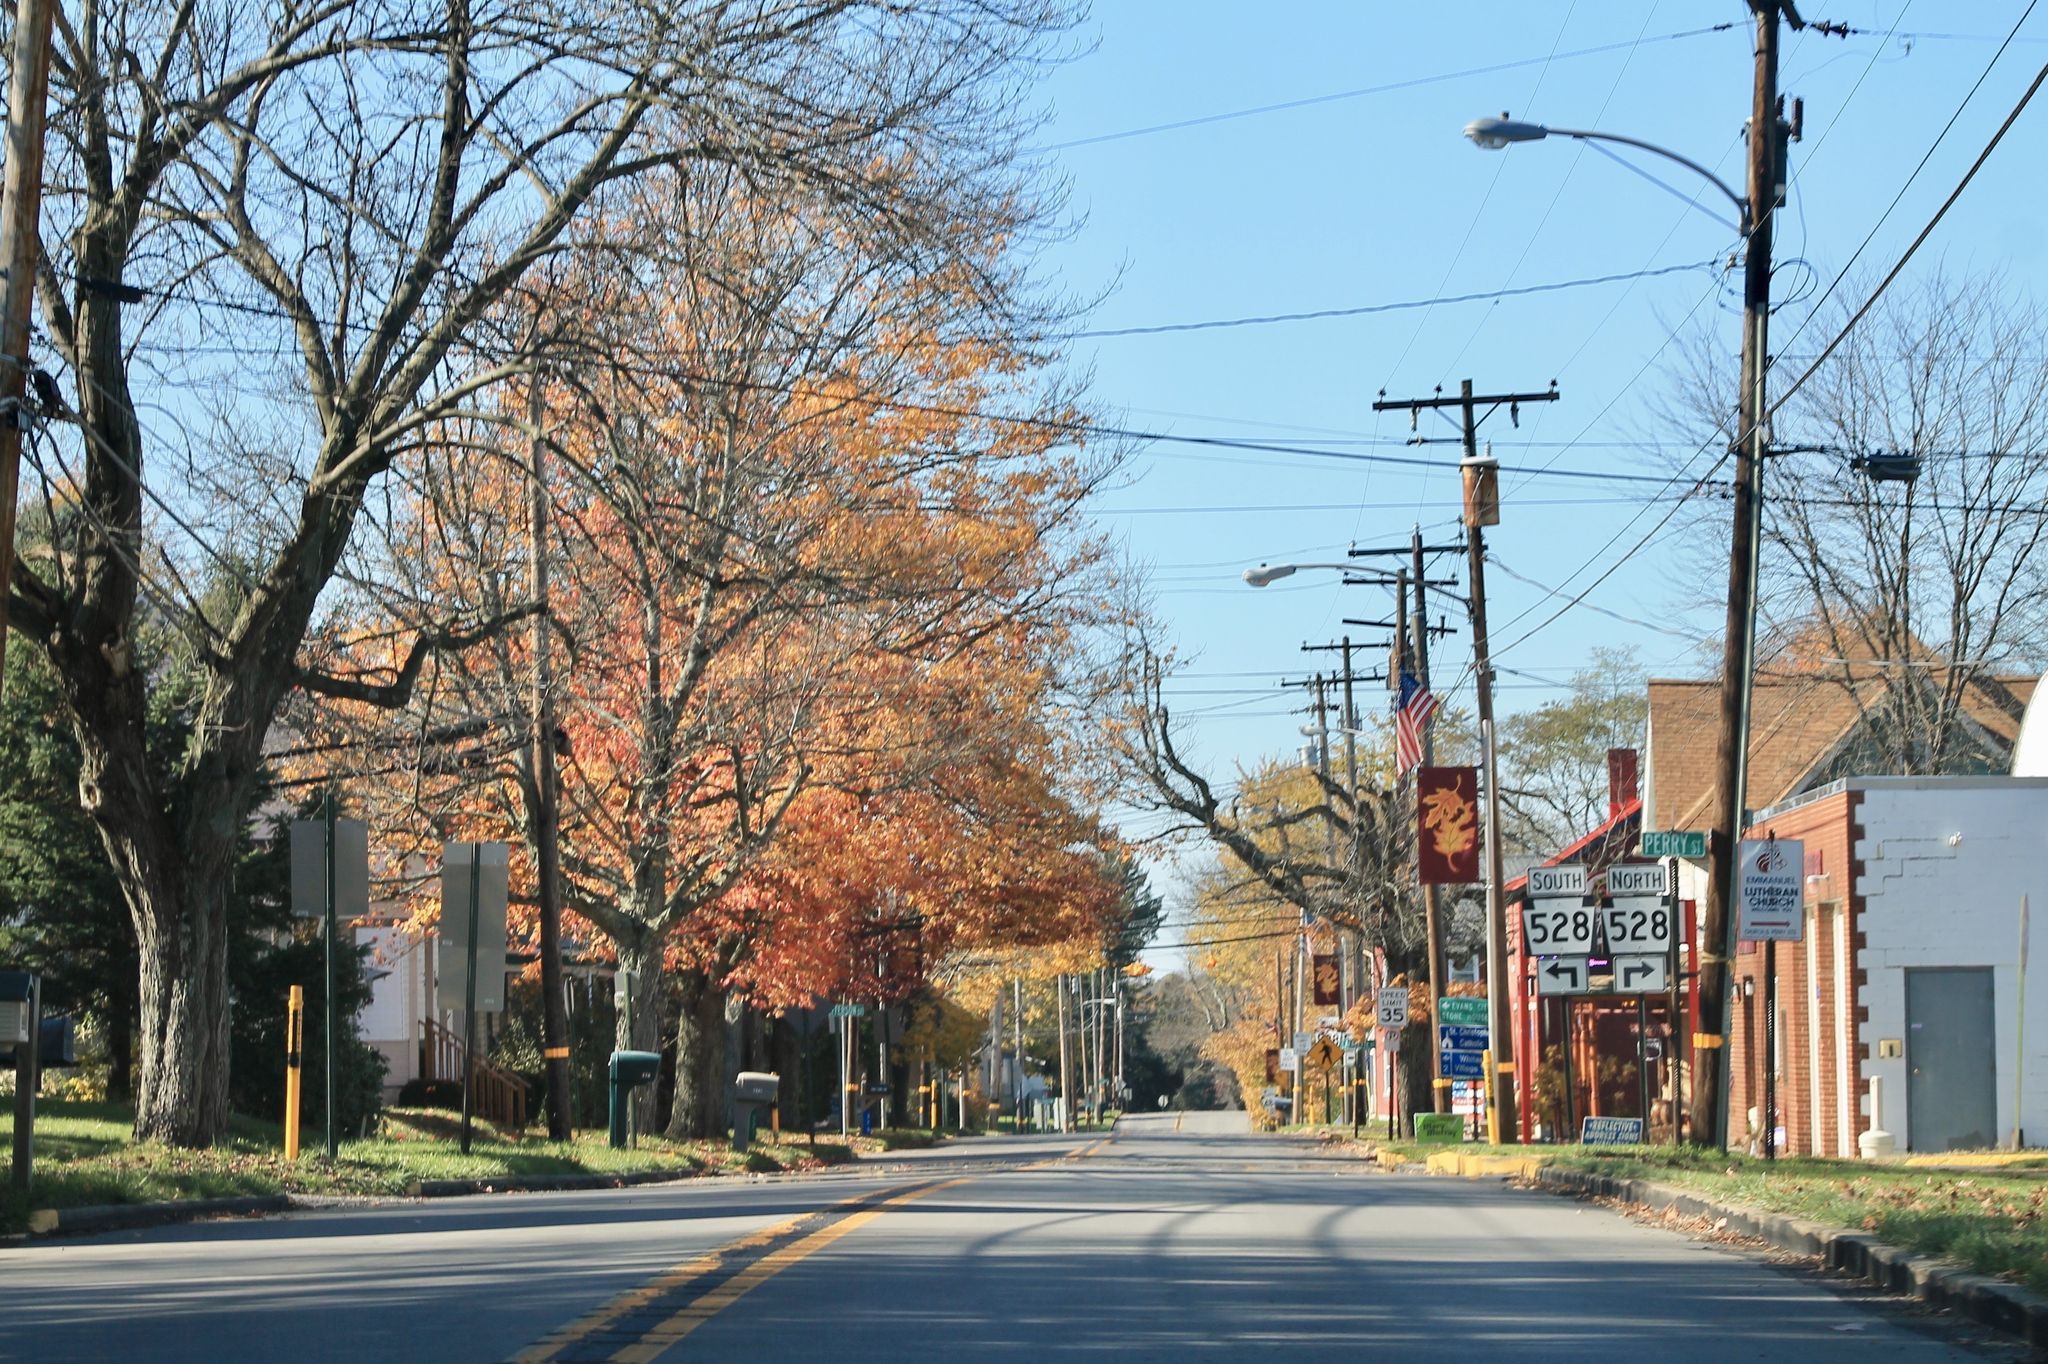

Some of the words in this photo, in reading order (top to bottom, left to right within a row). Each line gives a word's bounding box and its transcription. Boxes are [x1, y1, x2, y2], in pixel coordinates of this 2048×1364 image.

[1644, 833, 1688, 855] PERRY
[1533, 871, 1583, 890] SOUTH
[1612, 871, 1663, 890] NORTH
[1746, 876, 1796, 884] EMMANUEL
[1744, 887, 1799, 897] LUTHERAN
[1748, 897, 1795, 907] CHURCH
[1530, 911, 1590, 943] 528
[1610, 910, 1668, 942] 528
[1380, 991, 1406, 999] SPEED
[1451, 1002, 1473, 1011] EVANS
[1381, 1008, 1404, 1022] 35
[1591, 1119, 1634, 1131] REFLECTIVE
